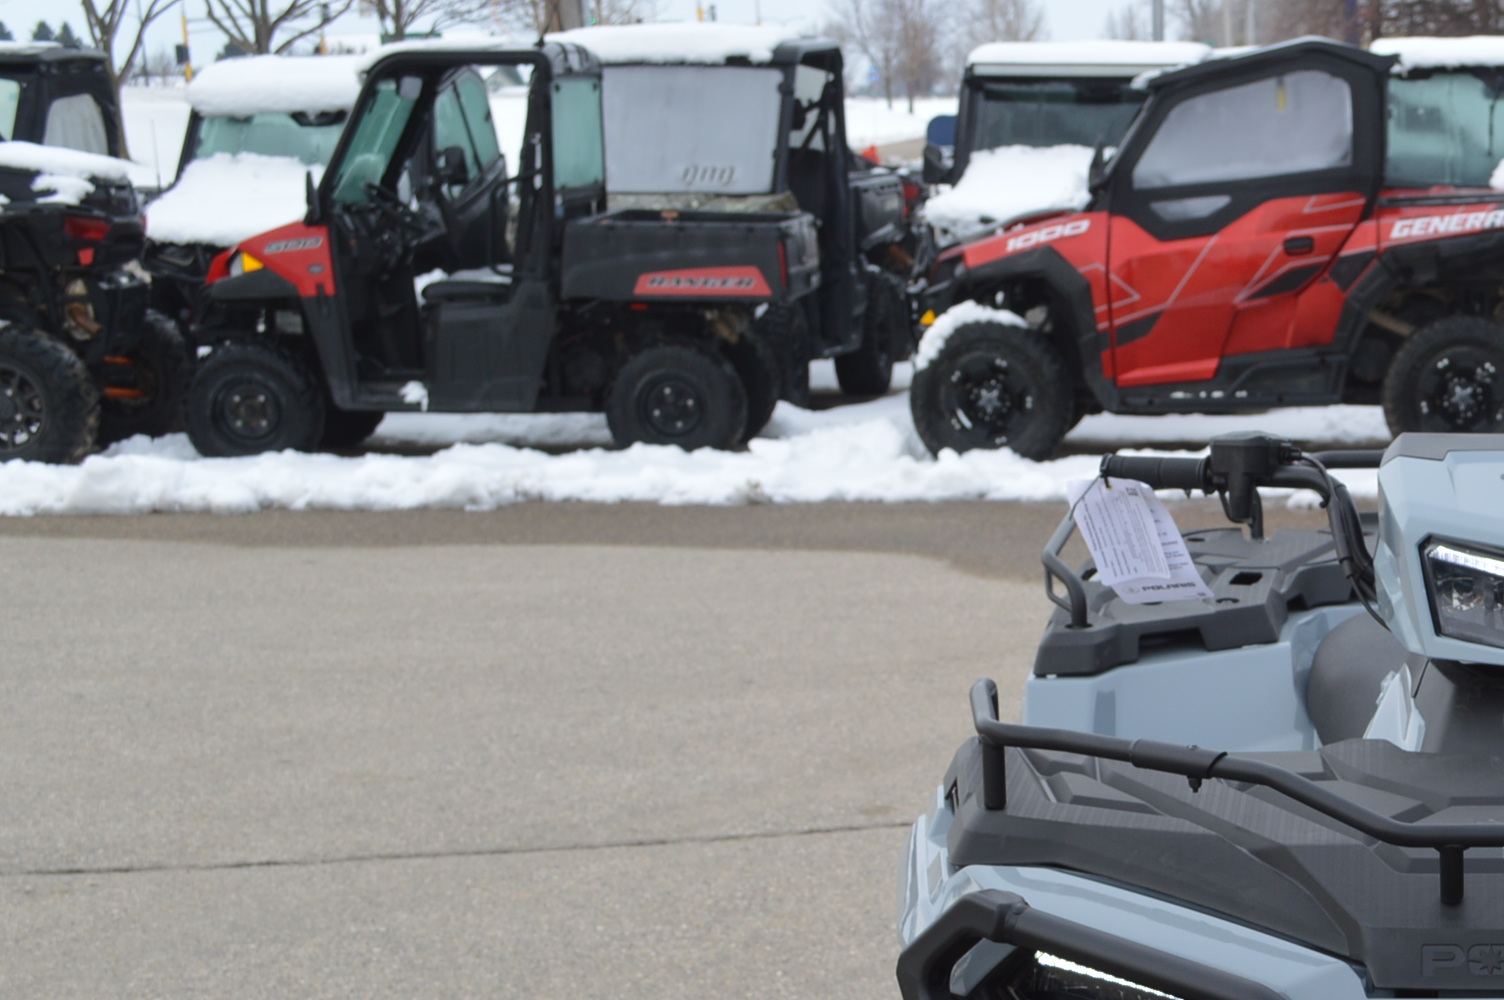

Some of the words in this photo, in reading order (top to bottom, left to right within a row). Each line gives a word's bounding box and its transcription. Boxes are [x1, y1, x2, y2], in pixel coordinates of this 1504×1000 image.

[1006, 218, 1092, 252] 1000
[646, 275, 755, 290] RANGER
[1141, 582, 1196, 592] POLARIS
